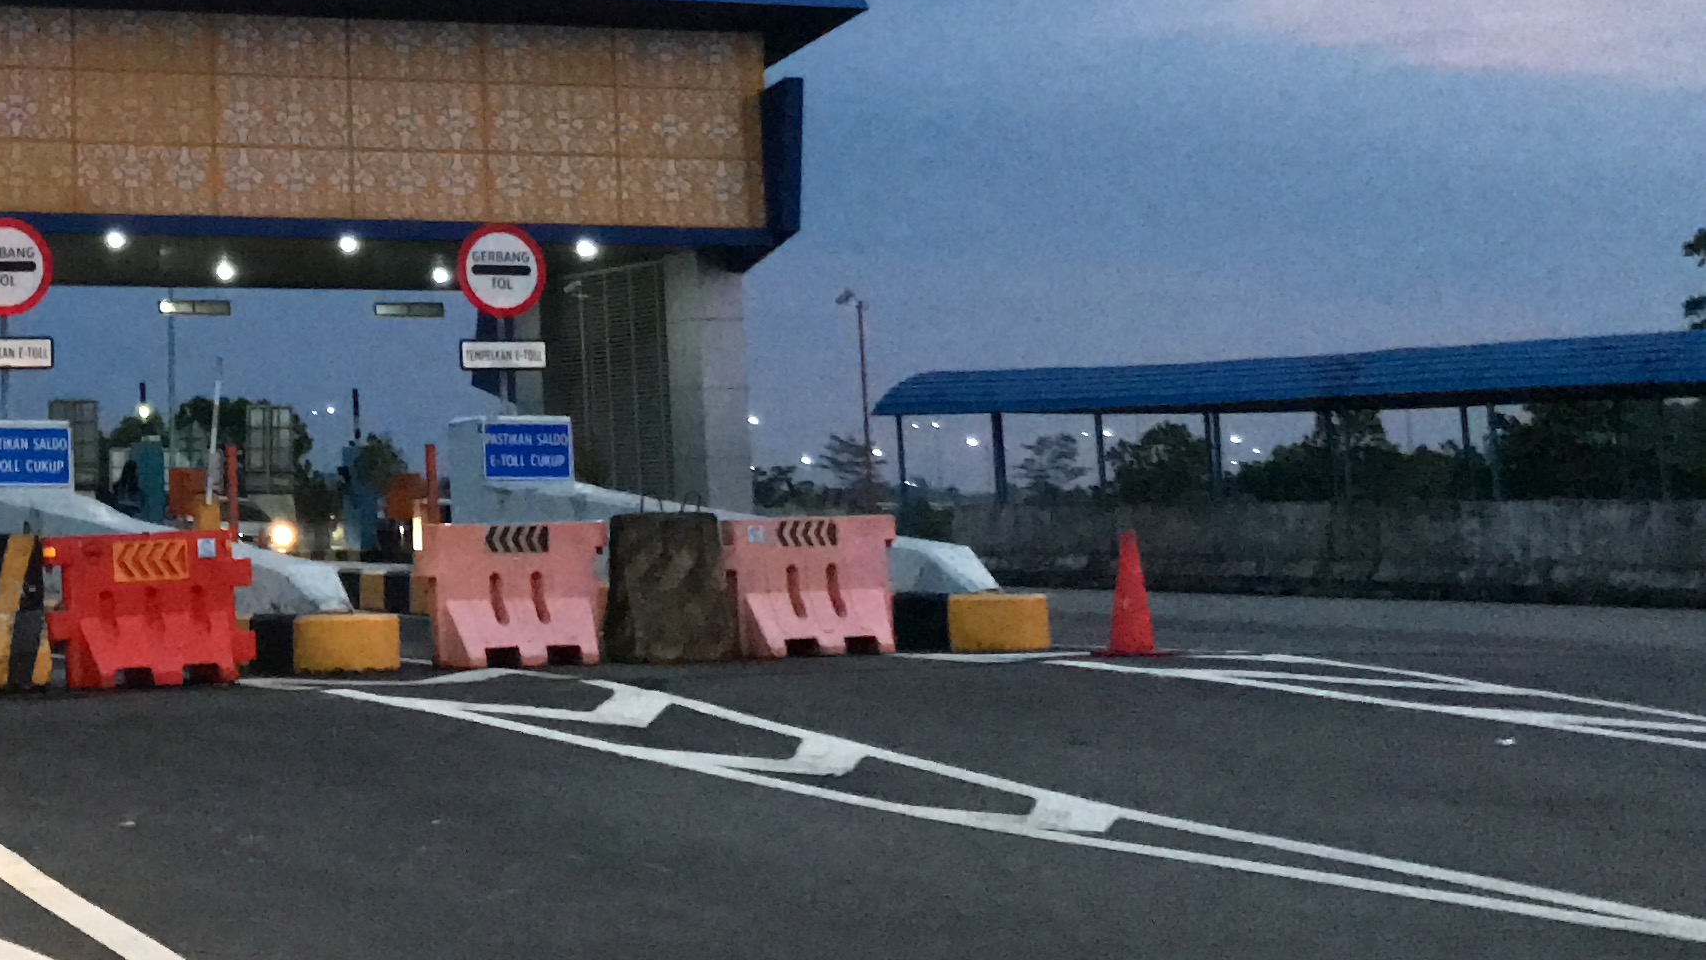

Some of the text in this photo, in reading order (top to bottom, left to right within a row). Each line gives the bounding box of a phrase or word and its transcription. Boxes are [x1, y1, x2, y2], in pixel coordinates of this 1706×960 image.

[472, 251, 530, 263] GERBANG
[492, 278, 512, 290] TOL
[33, 437, 67, 451] SALDO
[536, 432, 568, 447] SALDO
[25, 460, 64, 474] CUKUP
[490, 454, 525, 468] E-TOLL
